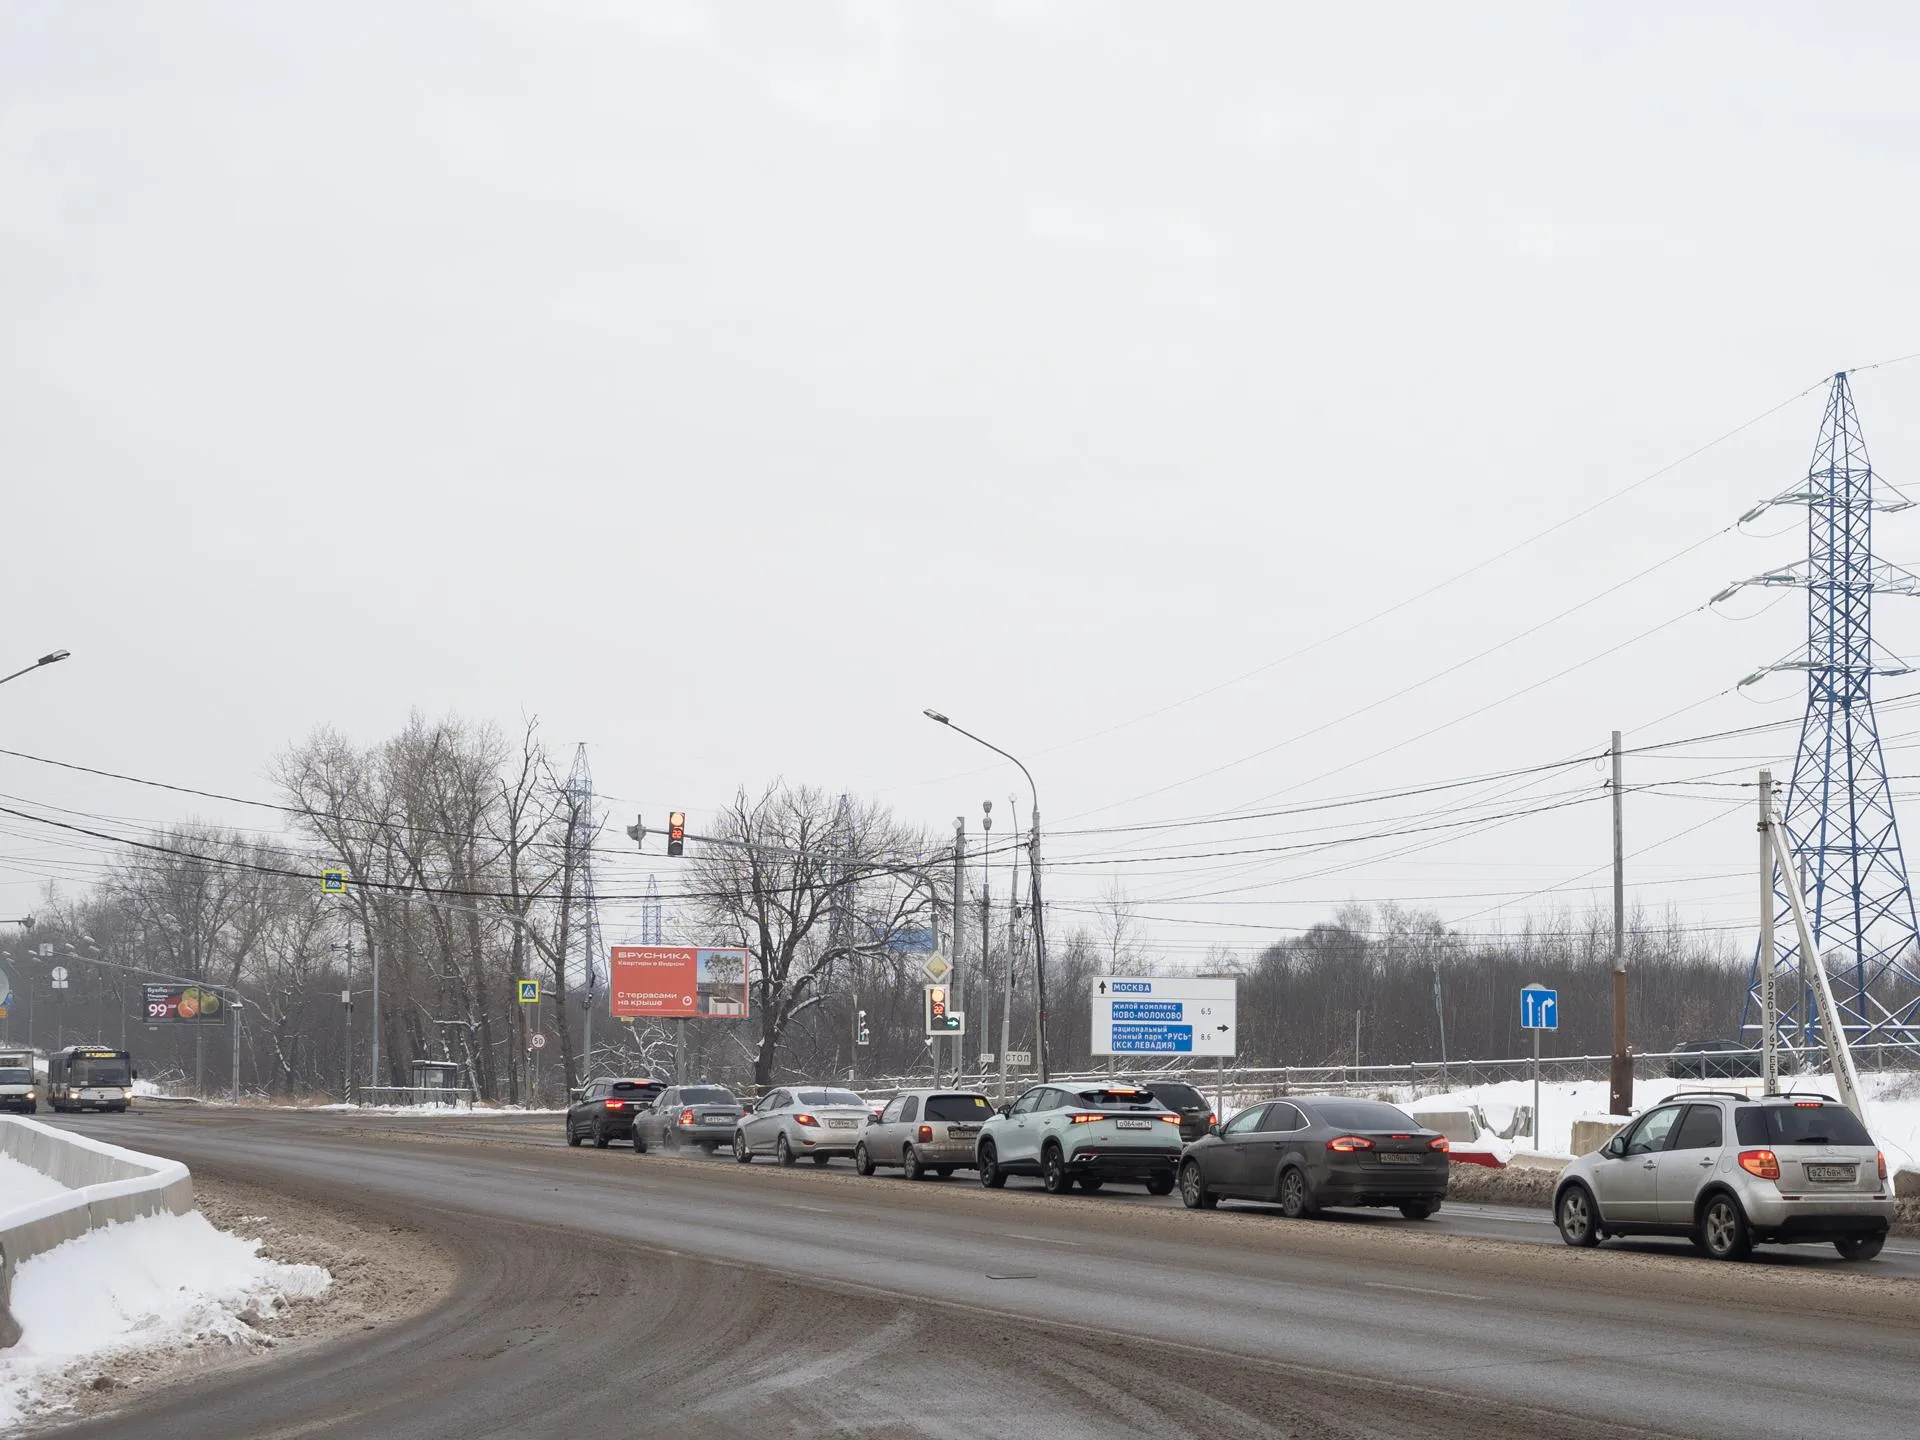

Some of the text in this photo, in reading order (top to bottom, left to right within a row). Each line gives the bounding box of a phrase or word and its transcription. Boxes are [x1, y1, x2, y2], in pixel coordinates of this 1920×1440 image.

[618, 951, 691, 960] БРУСНИКА
[1113, 983, 1150, 992] МОСКВА
[148, 1003, 167, 1017] 99
[1200, 1007, 1212, 1015] 6.5
[1113, 1011, 1182, 1020] НОВО-МОЛОКОВО
[534, 1037, 544, 1045] 50
[1200, 1033, 1212, 1041] 8.6
[1112, 1041, 1176, 1051] (КСК ЛЕВАДИЯ)
[1005, 1054, 1030, 1062] СТОП
